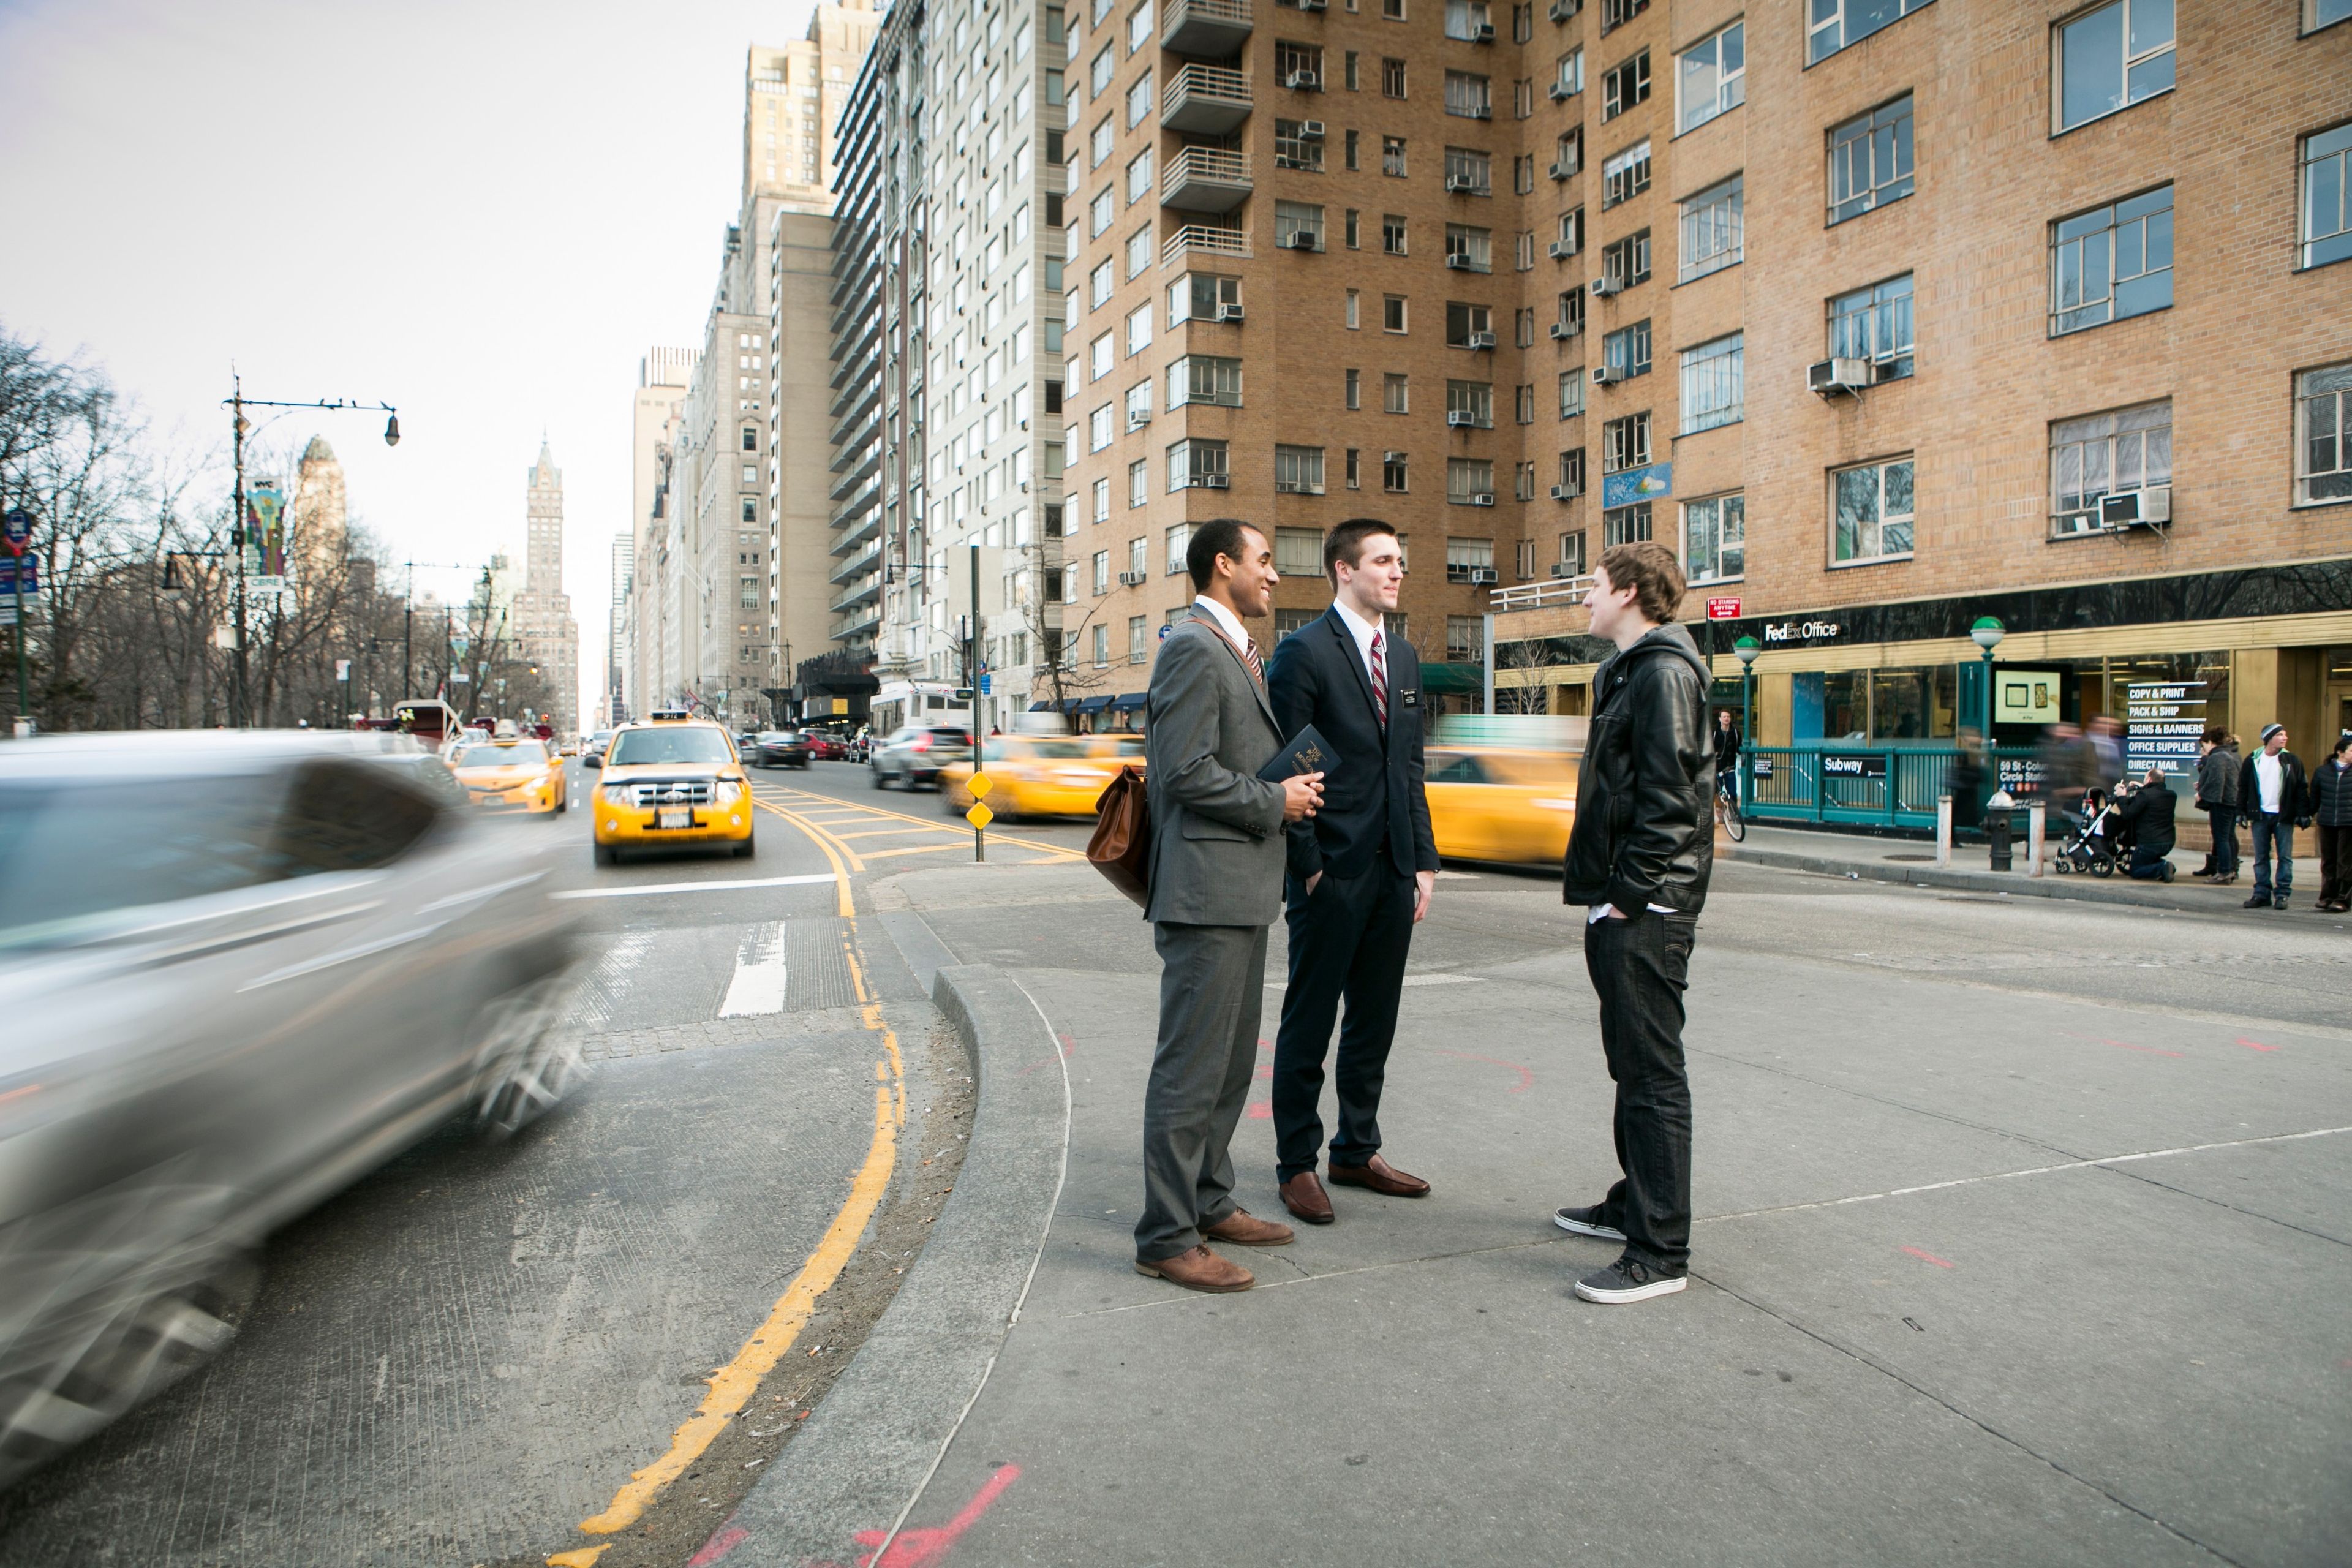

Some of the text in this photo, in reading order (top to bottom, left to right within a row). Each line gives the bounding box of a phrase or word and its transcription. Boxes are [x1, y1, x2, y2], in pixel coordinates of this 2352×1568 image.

[1765, 621, 1838, 641] FedEx Office
[2129, 687, 2185, 699] COPY & PRINT
[2129, 706, 2179, 717] PACK & SHIP
[2129, 723, 2204, 734] SIGNS & BANNERS
[2128, 742, 2196, 753] OFFICE SUPPLIES
[1306, 748, 1320, 764] BOOK
[1825, 757, 1862, 774] Subway
[2000, 761, 2011, 771] 59
[2128, 760, 2179, 771] DIRECT MAIL
[2000, 772, 2024, 782] Circle
